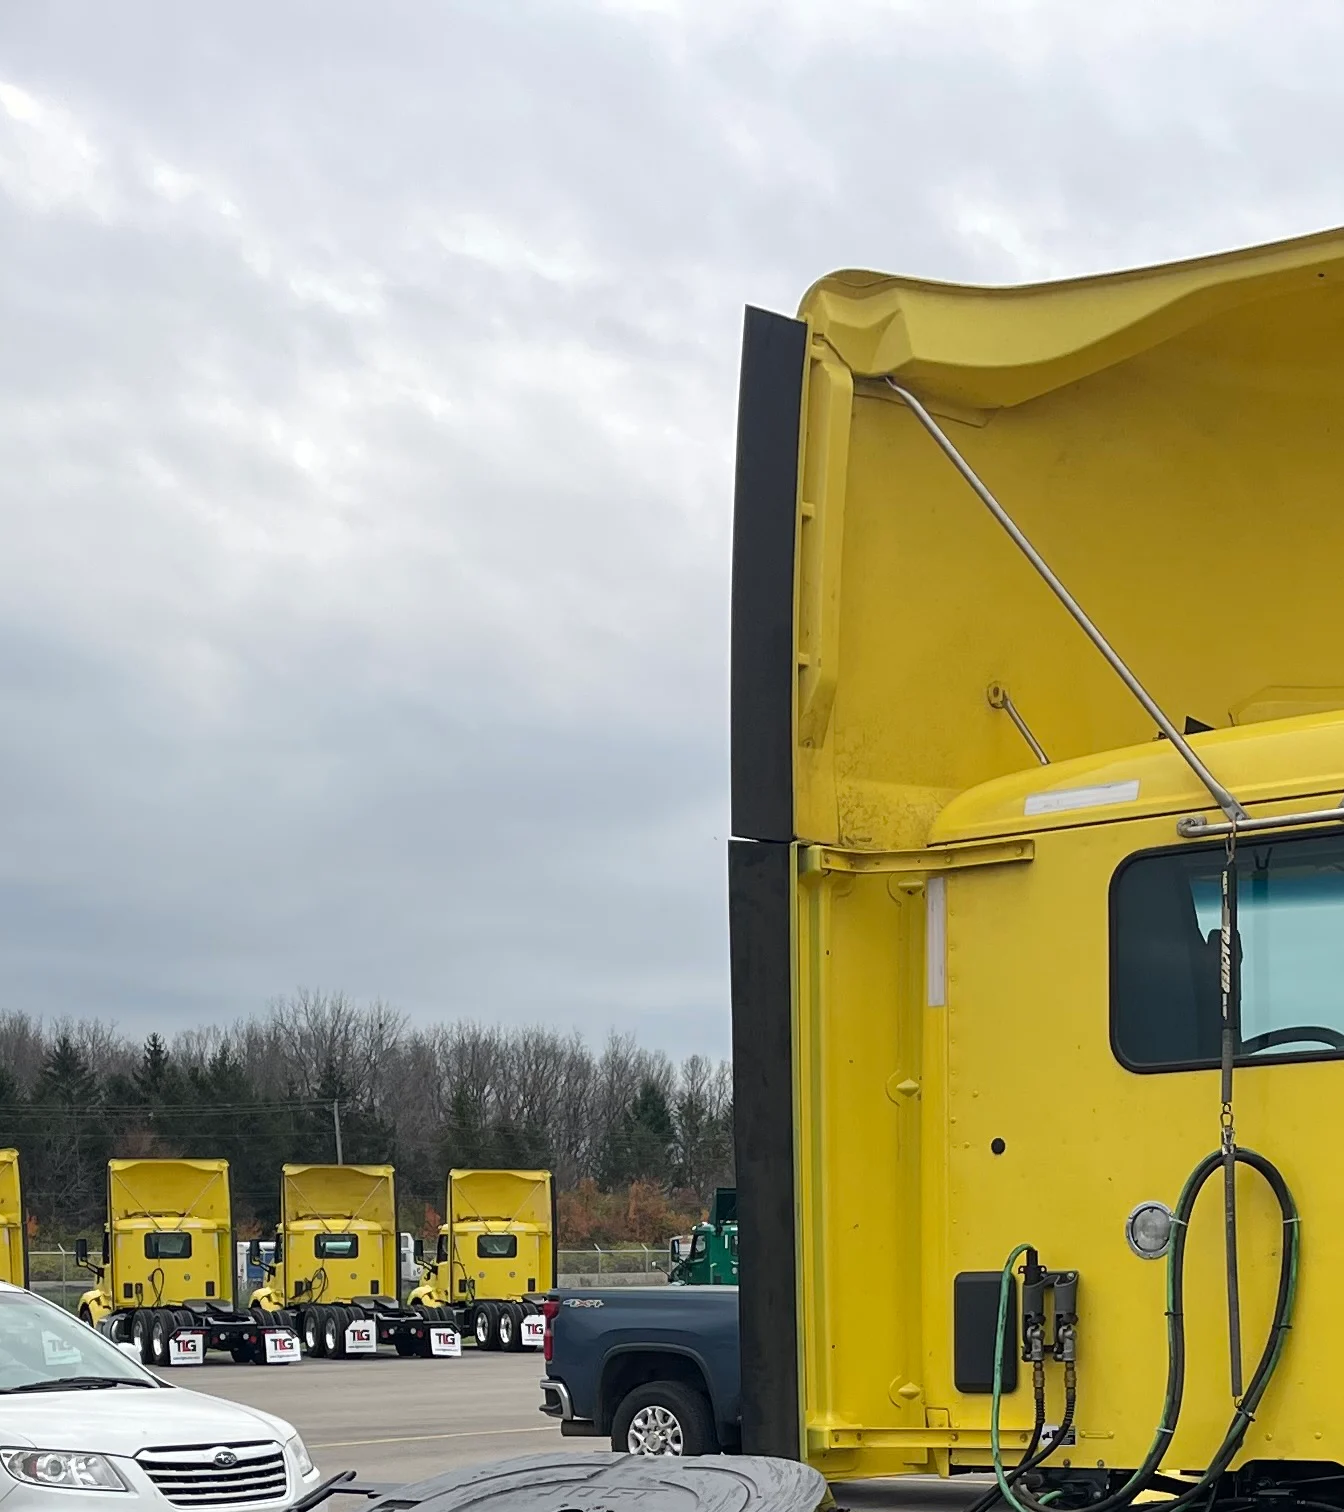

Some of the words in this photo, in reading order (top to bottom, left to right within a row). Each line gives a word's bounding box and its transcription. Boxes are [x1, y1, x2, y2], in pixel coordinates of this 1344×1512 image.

[350, 1329, 370, 1341] TLG
[435, 1333, 455, 1345] TLG
[176, 1339, 197, 1352] TLG
[270, 1338, 294, 1351] TLG
